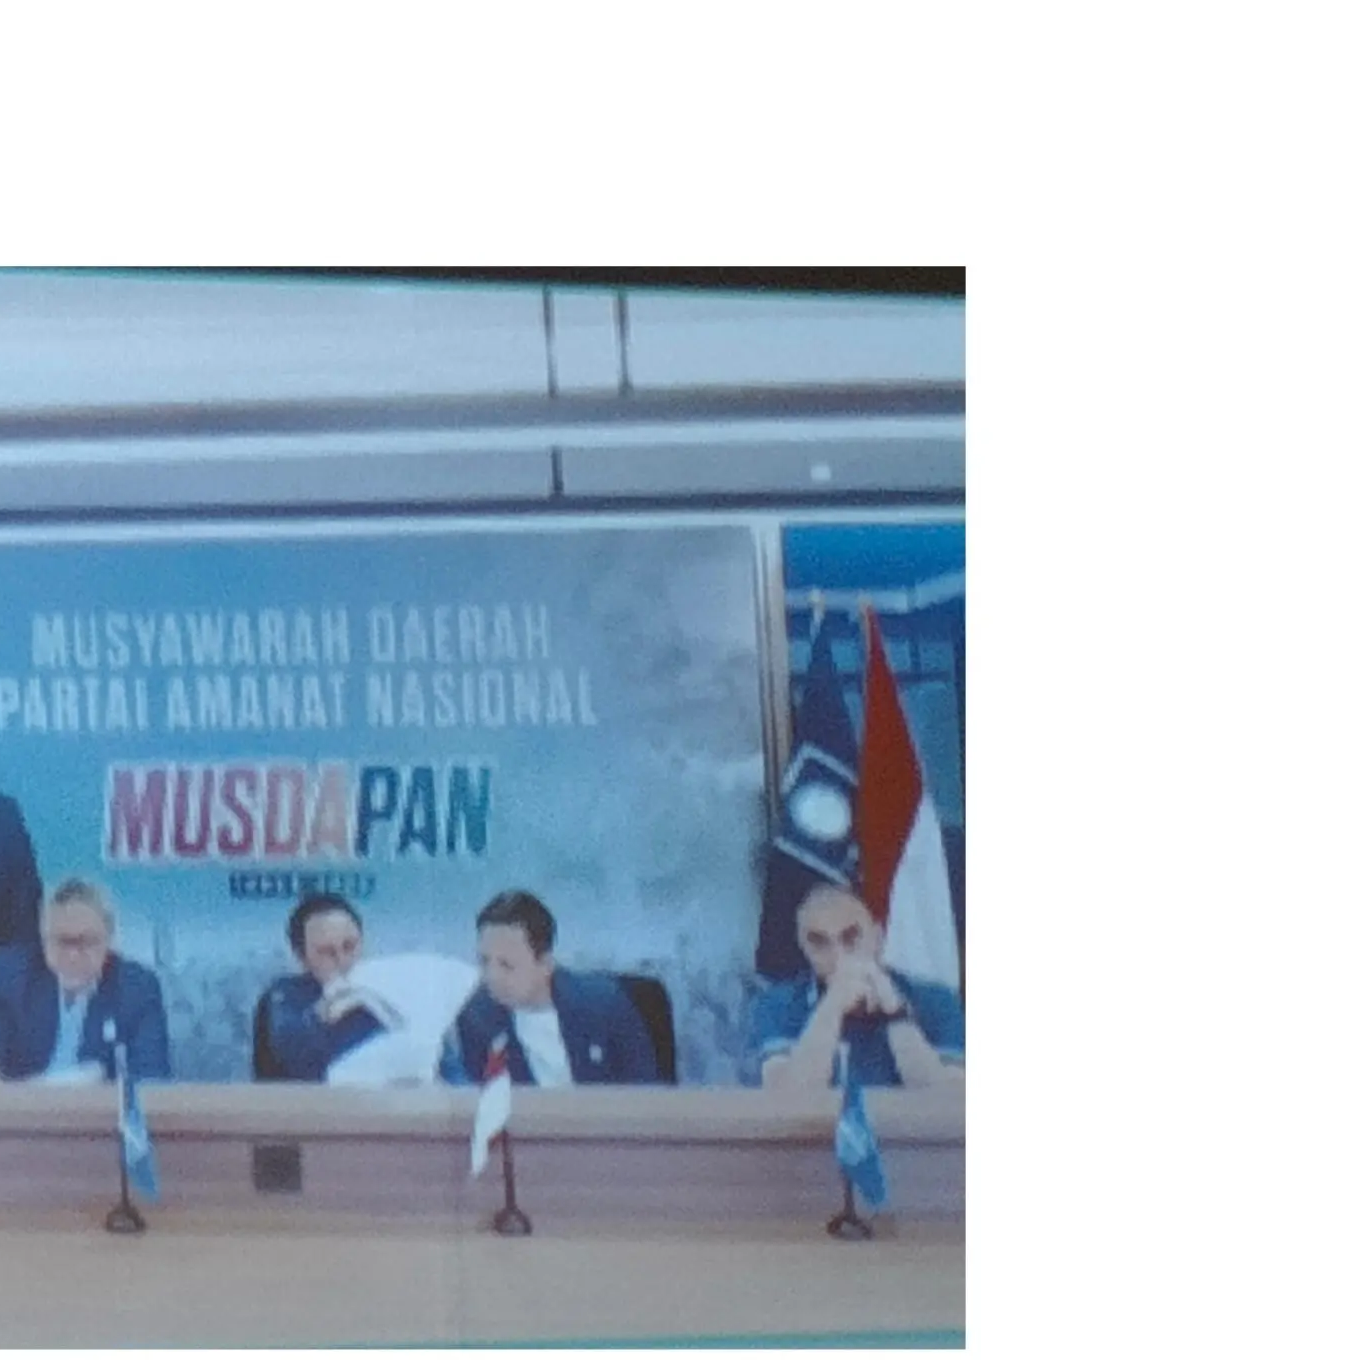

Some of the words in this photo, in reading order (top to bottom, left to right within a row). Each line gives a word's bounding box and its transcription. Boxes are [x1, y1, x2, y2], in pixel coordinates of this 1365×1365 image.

[31, 607, 351, 668] MUSYAWARAH
[373, 603, 552, 664] DAERAH
[167, 671, 348, 730] AMANAT
[369, 666, 597, 728] NASIONAL
